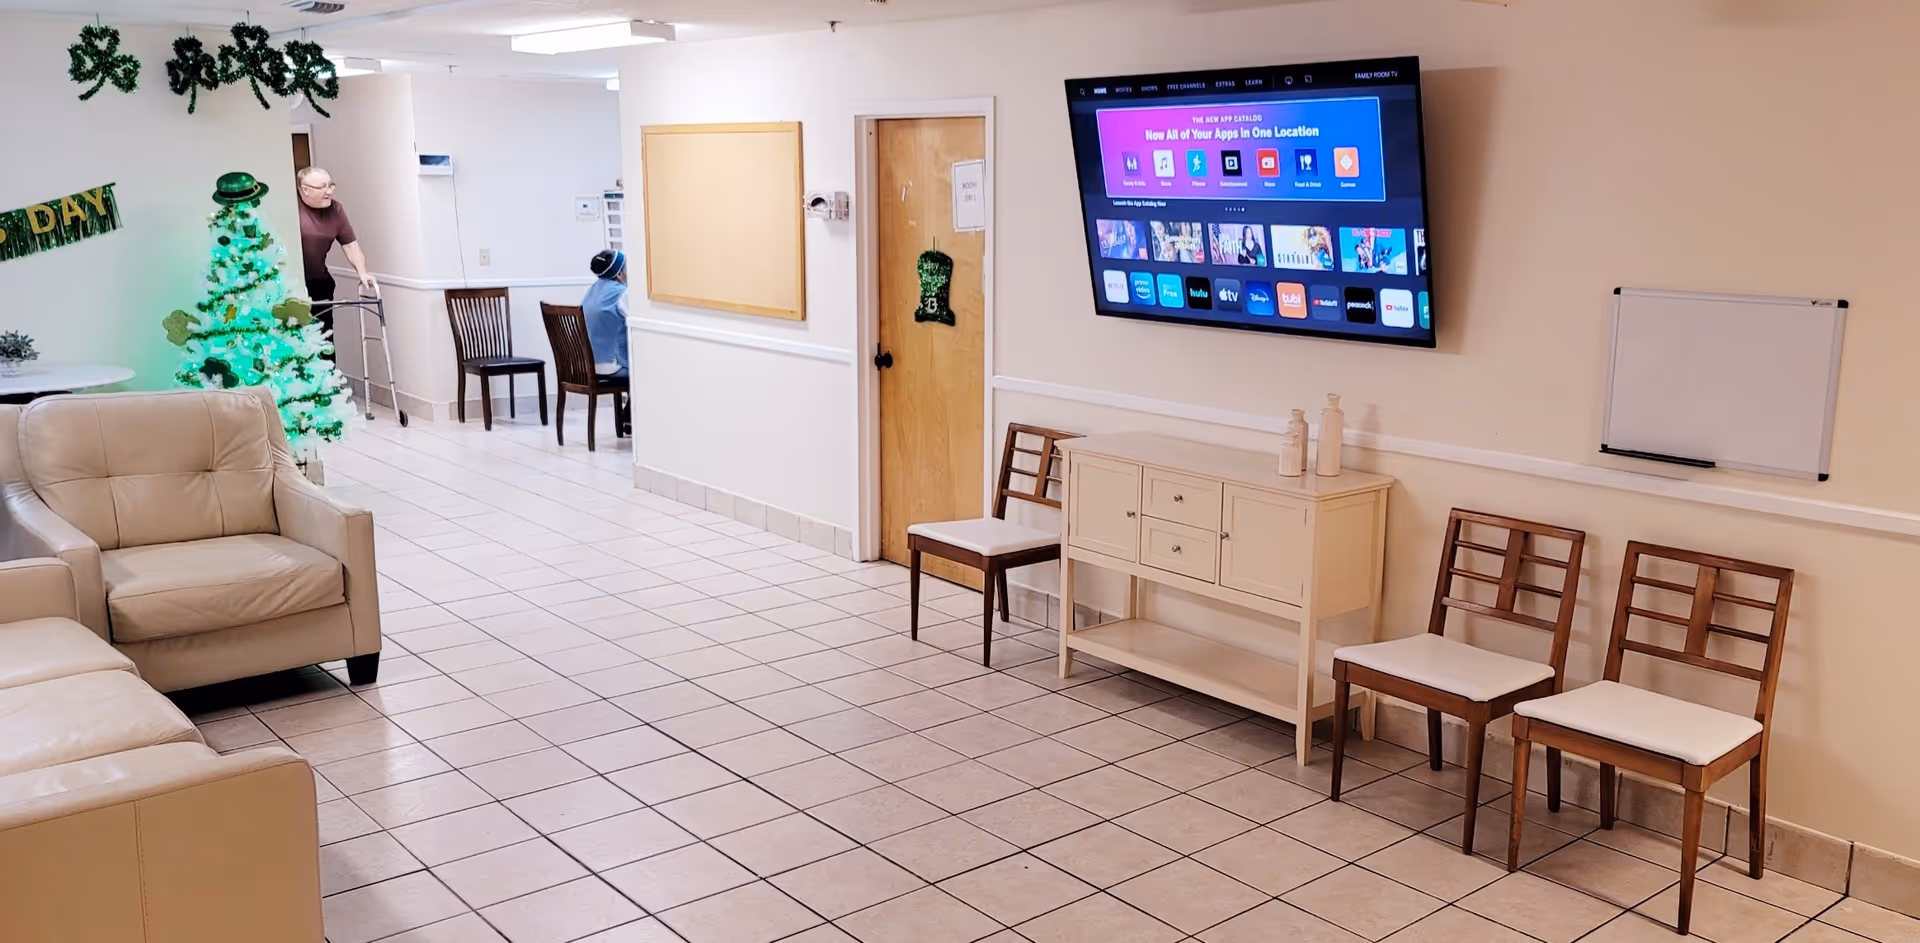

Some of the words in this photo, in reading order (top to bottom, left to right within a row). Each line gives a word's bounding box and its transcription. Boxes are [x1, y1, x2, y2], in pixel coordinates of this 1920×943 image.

[1391, 70, 1398, 78] TV
[1216, 80, 1235, 88] EXTRAS
[1192, 116, 1204, 124] THE
[1220, 115, 1232, 123] APP
[1233, 114, 1263, 123] CATALOG
[1145, 129, 1165, 141] Now
[1166, 128, 1179, 140] All
[1180, 128, 1190, 140] of
[1191, 128, 1213, 140] Your
[1214, 127, 1239, 141] Apps
[1252, 126, 1272, 139] One
[1274, 125, 1319, 138] Location
[26, 187, 106, 234] DAY
[1219, 238, 1243, 256] FAITH
[1136, 286, 1151, 294] video
[1163, 288, 1178, 298] Free
[1189, 288, 1208, 298] hulu
[1227, 290, 1238, 302] tv
[1281, 293, 1301, 304] tubi
[1346, 301, 1372, 310] peacock
